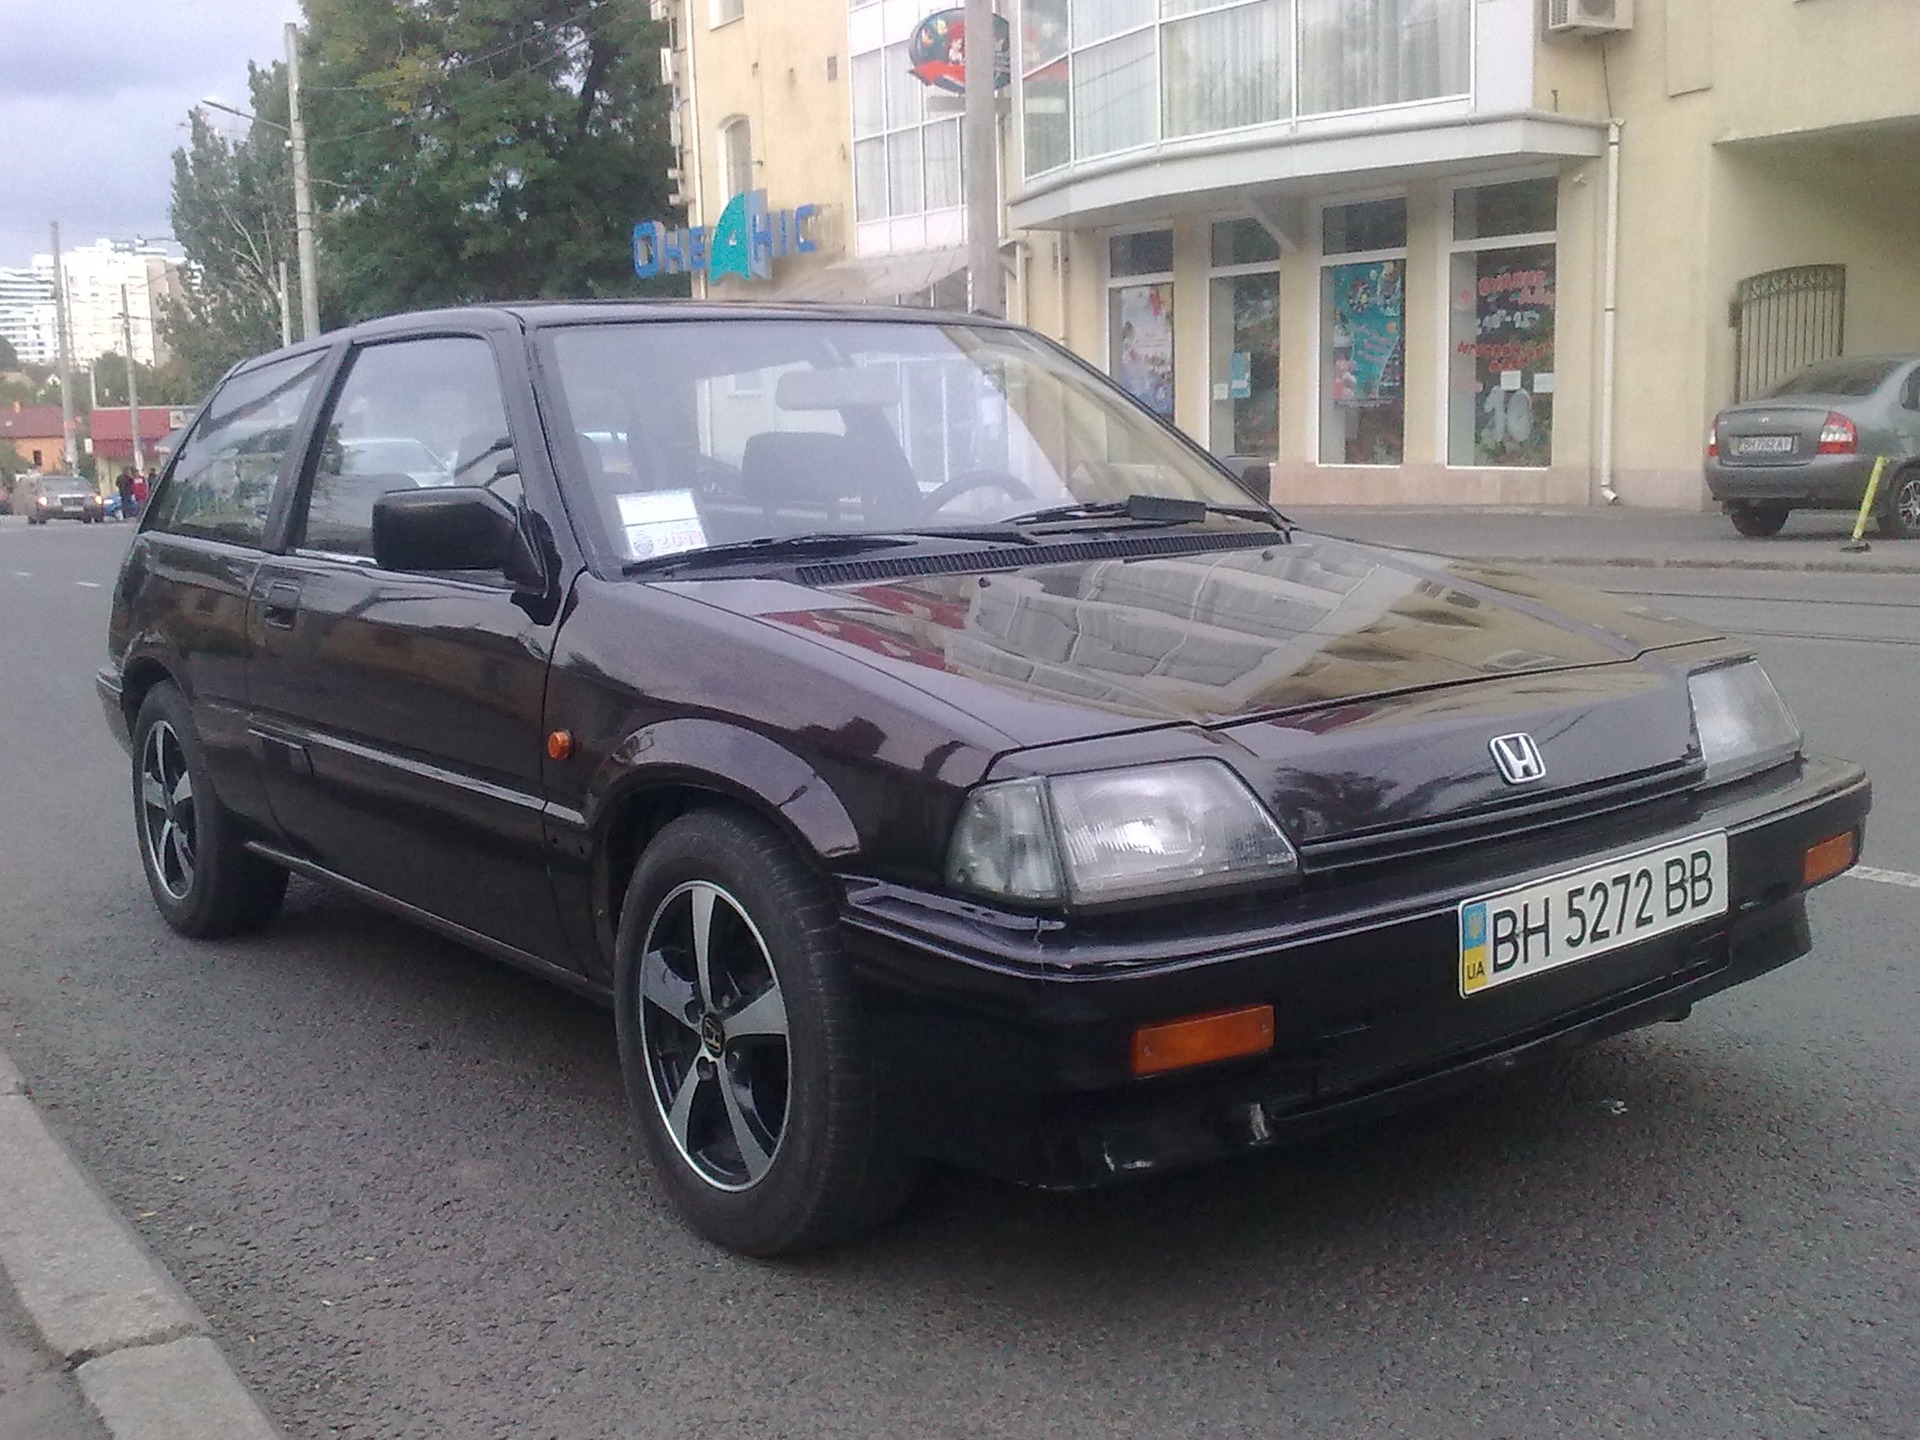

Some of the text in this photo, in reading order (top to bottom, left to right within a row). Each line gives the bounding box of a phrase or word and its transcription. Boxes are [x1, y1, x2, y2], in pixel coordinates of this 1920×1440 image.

[1492, 849, 1714, 974] BH 5272 BB
[1467, 962, 1486, 981] UA
